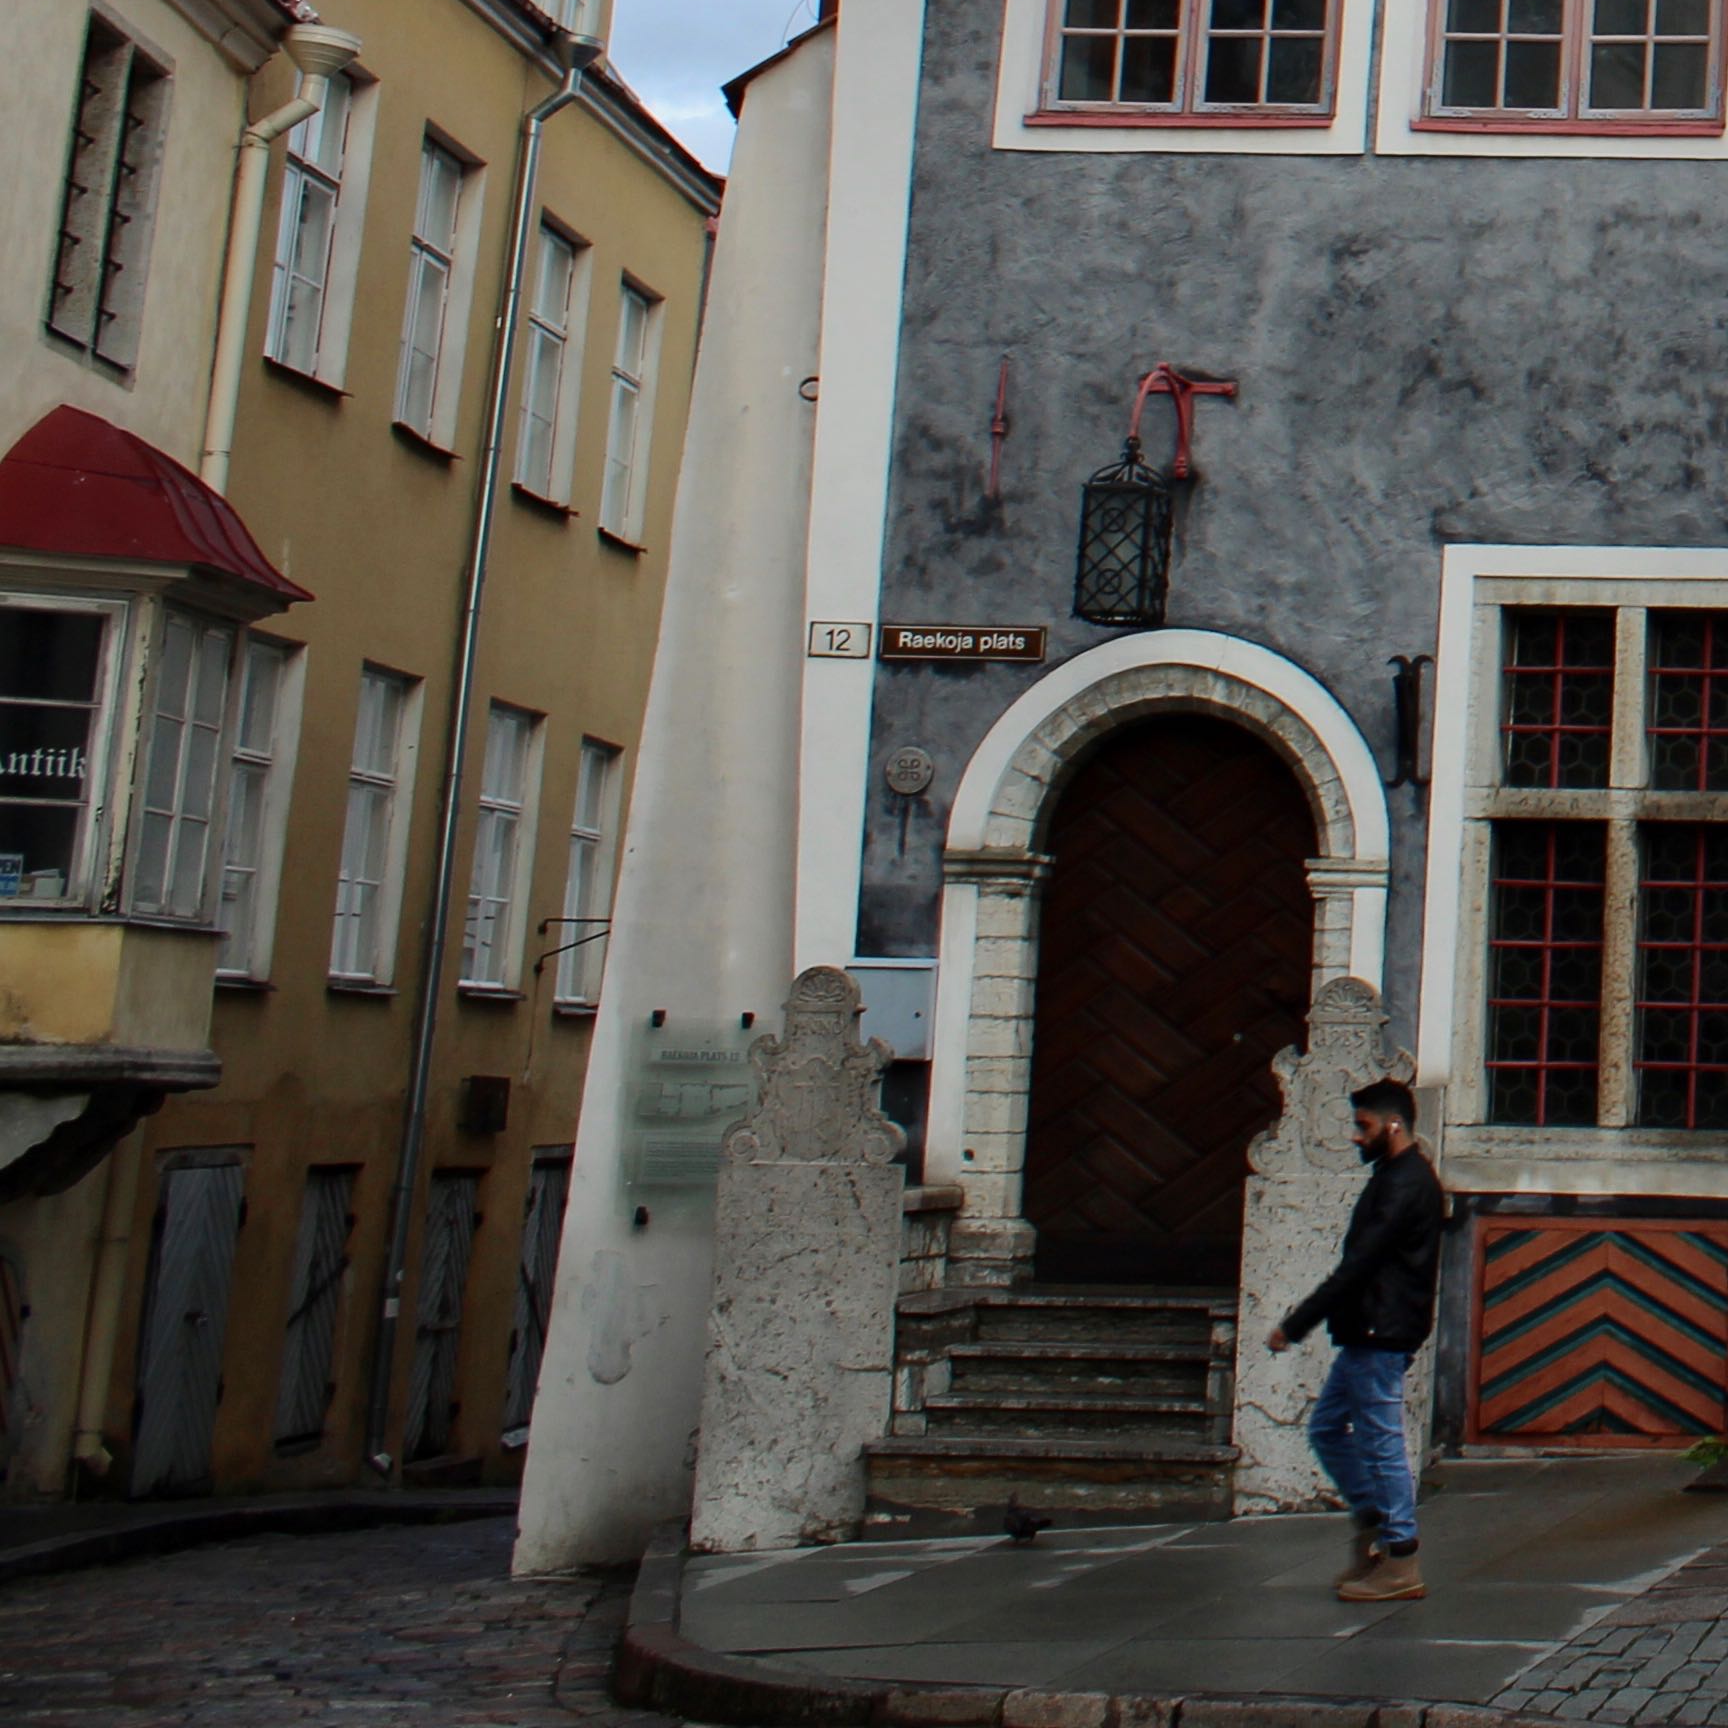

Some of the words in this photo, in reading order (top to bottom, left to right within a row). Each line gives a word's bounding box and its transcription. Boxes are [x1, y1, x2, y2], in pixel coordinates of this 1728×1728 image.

[825, 628, 852, 652] 12
[898, 631, 973, 654] Raekoja
[979, 632, 1026, 651] plats
[0, 746, 88, 779] ntiik
